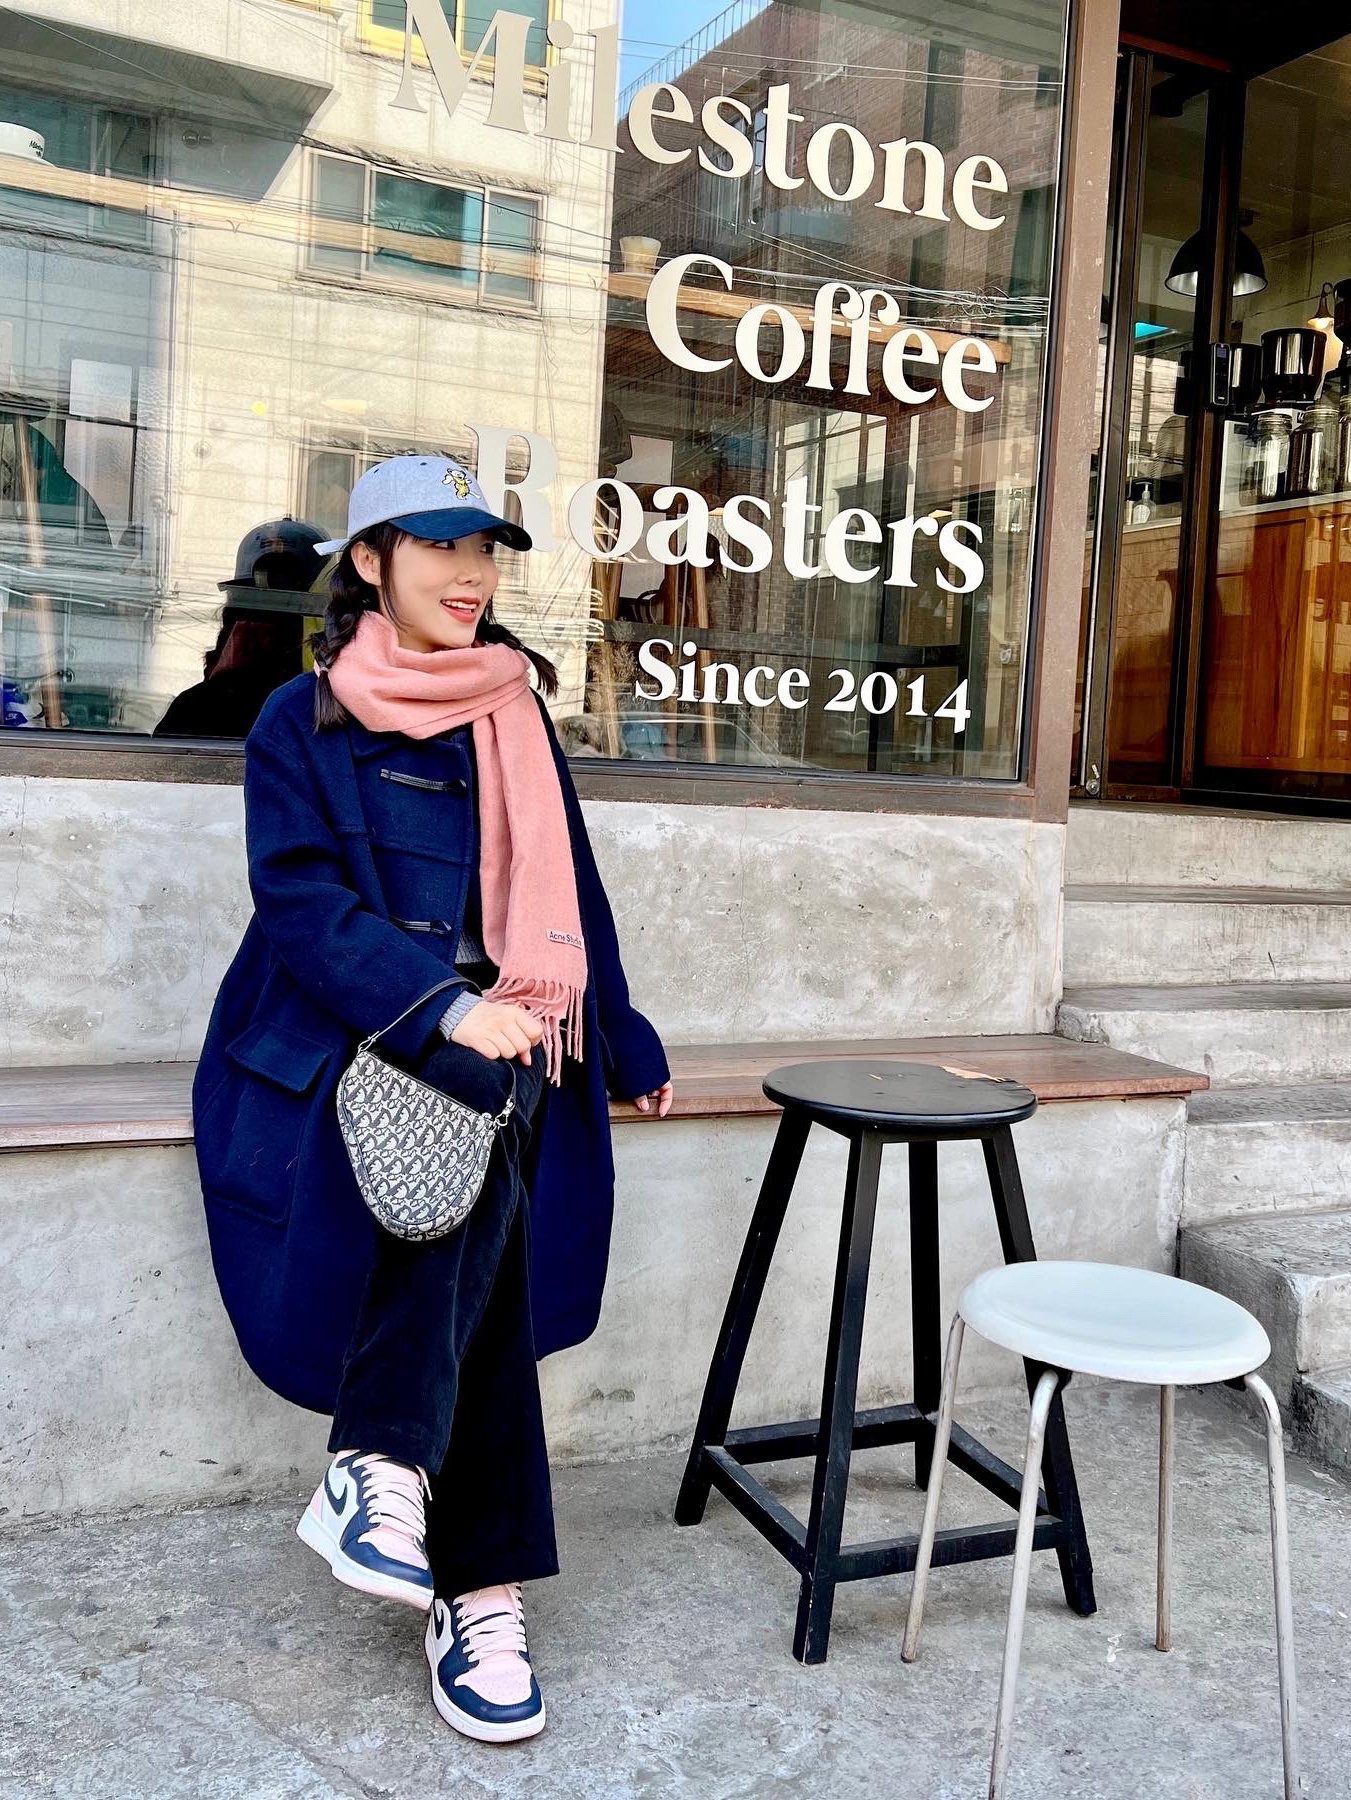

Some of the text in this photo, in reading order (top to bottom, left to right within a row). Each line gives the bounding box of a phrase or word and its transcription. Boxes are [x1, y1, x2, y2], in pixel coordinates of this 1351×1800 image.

[388, 0, 1009, 231] Milestone
[646, 253, 997, 413] Coffee
[463, 423, 985, 594] Roasters
[635, 638, 971, 734] Since 2014
[549, 931, 566, 941] Acne
